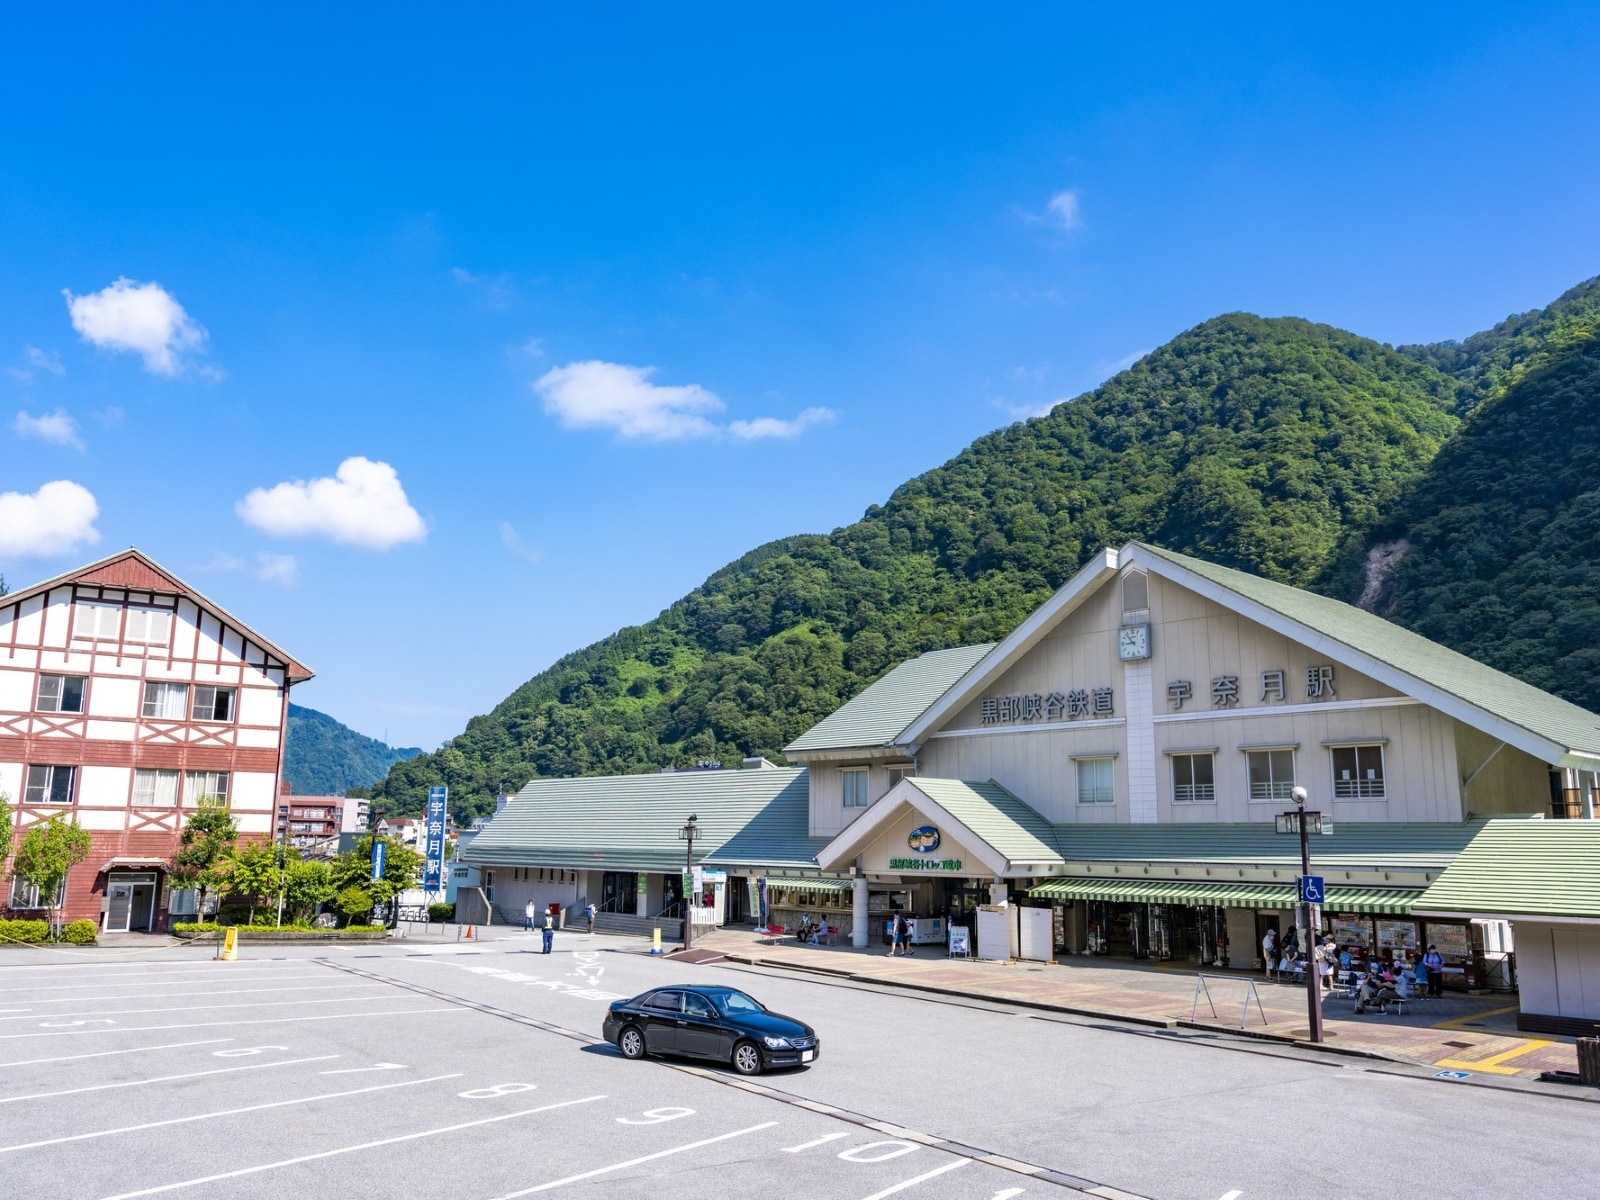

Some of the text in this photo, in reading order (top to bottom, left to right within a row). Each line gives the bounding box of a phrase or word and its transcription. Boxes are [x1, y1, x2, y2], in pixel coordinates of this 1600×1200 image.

[1166, 664, 1336, 710] 宇奈月駅
[980, 687, 1114, 724] 黒部峡谷鉄道
[427, 801, 444, 875] 宇奈月駅
[889, 858, 962, 871] 黒部峡谷トロッコ電車
[39, 1018, 116, 1028] 5
[212, 1045, 289, 1058] 6
[457, 1082, 538, 1100] 8
[615, 1106, 697, 1125] 9
[780, 1131, 921, 1164] 10
